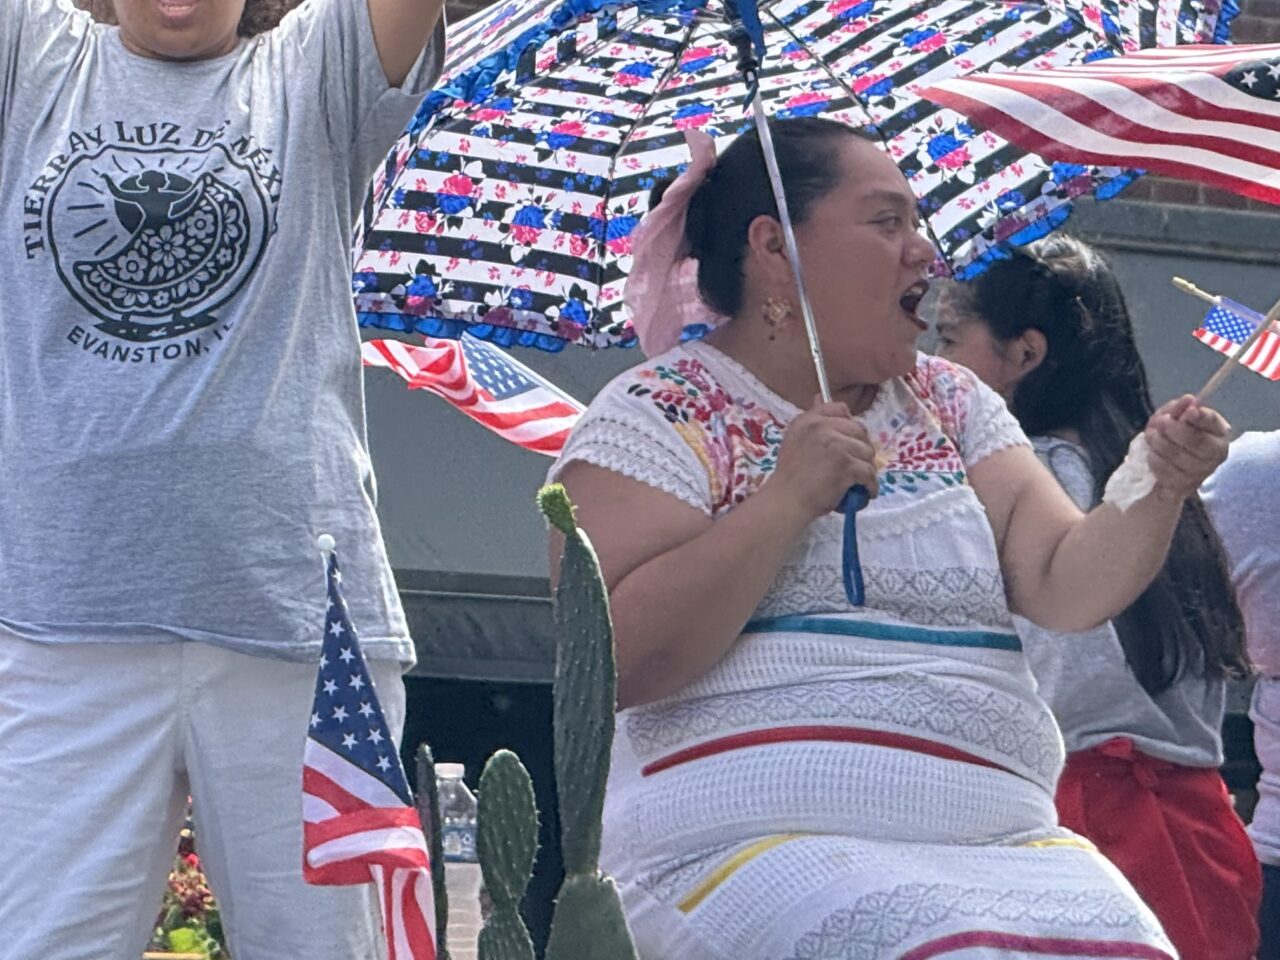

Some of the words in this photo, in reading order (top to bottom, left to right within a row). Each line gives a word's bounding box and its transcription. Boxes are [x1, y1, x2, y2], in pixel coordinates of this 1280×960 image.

[24, 131, 89, 260] TIERRA
[83, 124, 106, 148] Y
[114, 120, 181, 146] LUZ
[67, 325, 210, 363] EVANSTON,
[213, 321, 234, 341] IL
